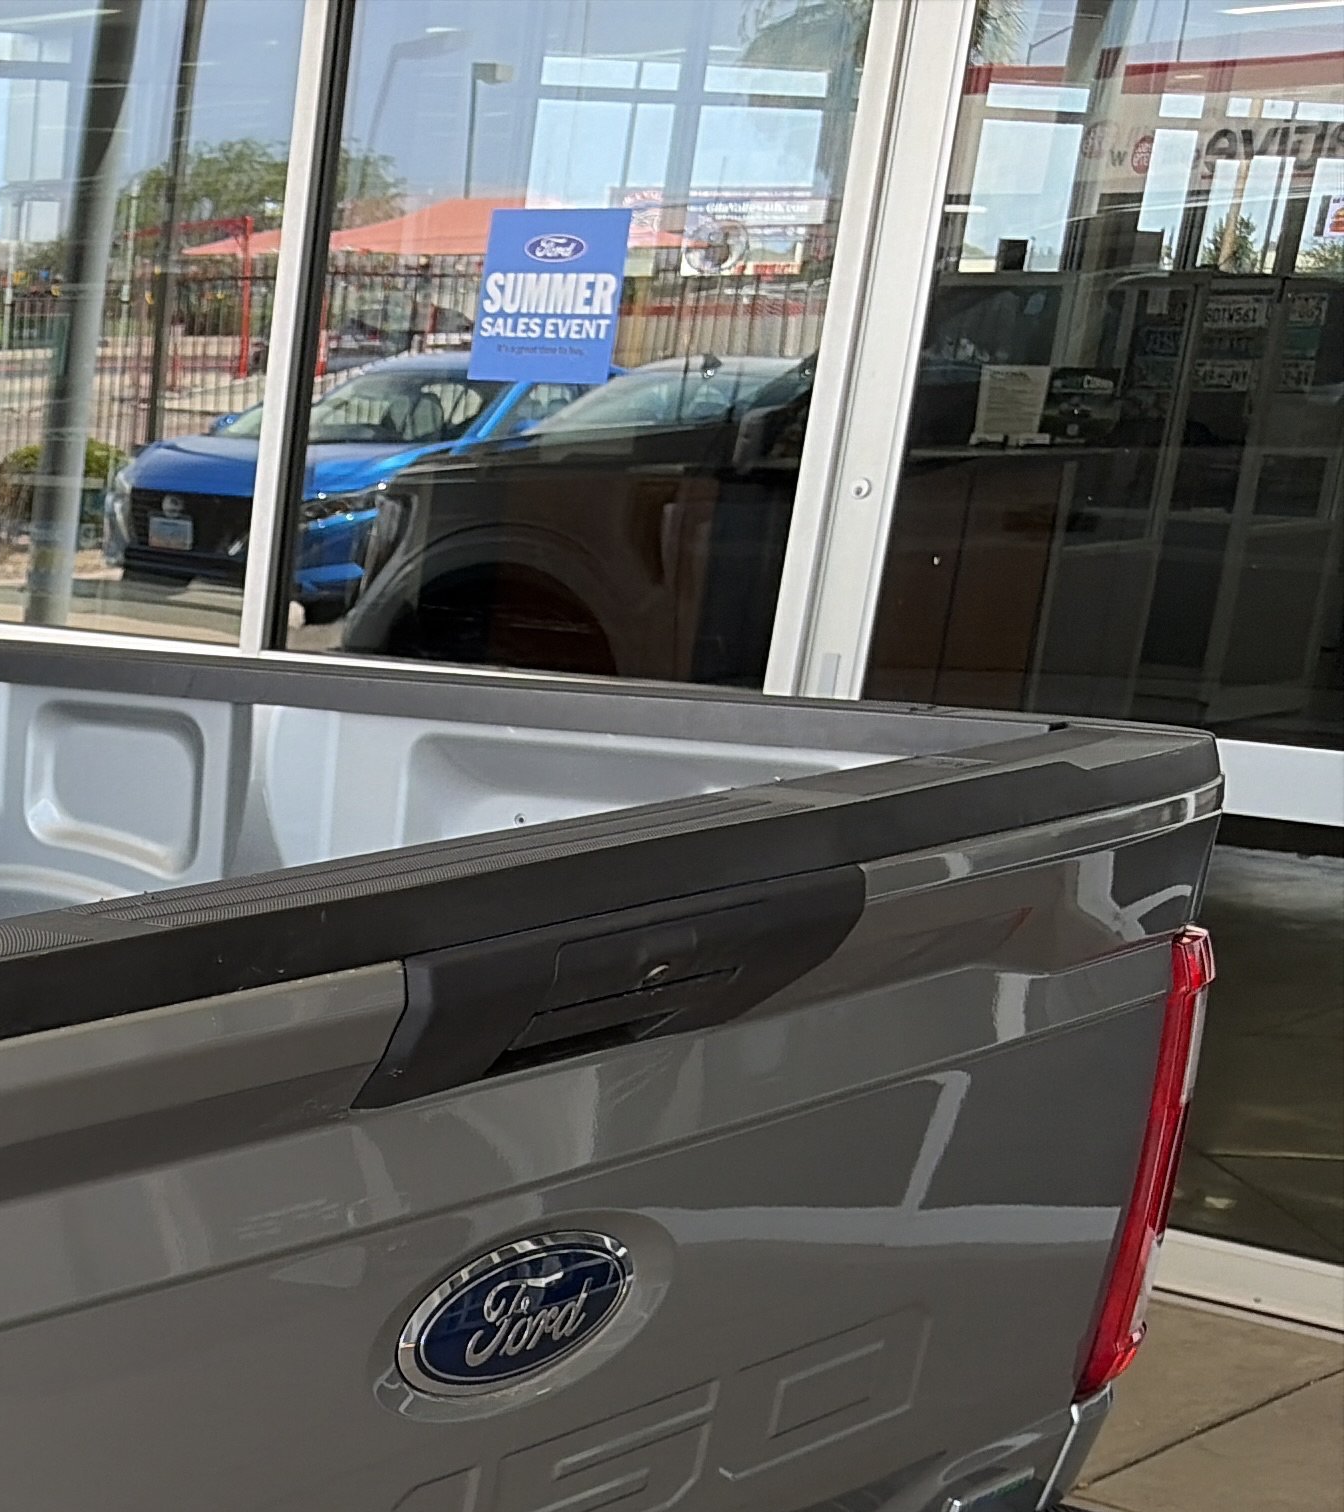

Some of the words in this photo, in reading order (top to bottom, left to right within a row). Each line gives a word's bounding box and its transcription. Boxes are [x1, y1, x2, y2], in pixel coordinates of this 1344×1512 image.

[535, 237, 577, 258] Ford
[482, 272, 617, 315] SUMMER
[480, 317, 542, 338] SALES
[544, 318, 611, 340] EVENT
[464, 1271, 594, 1368] Ford
